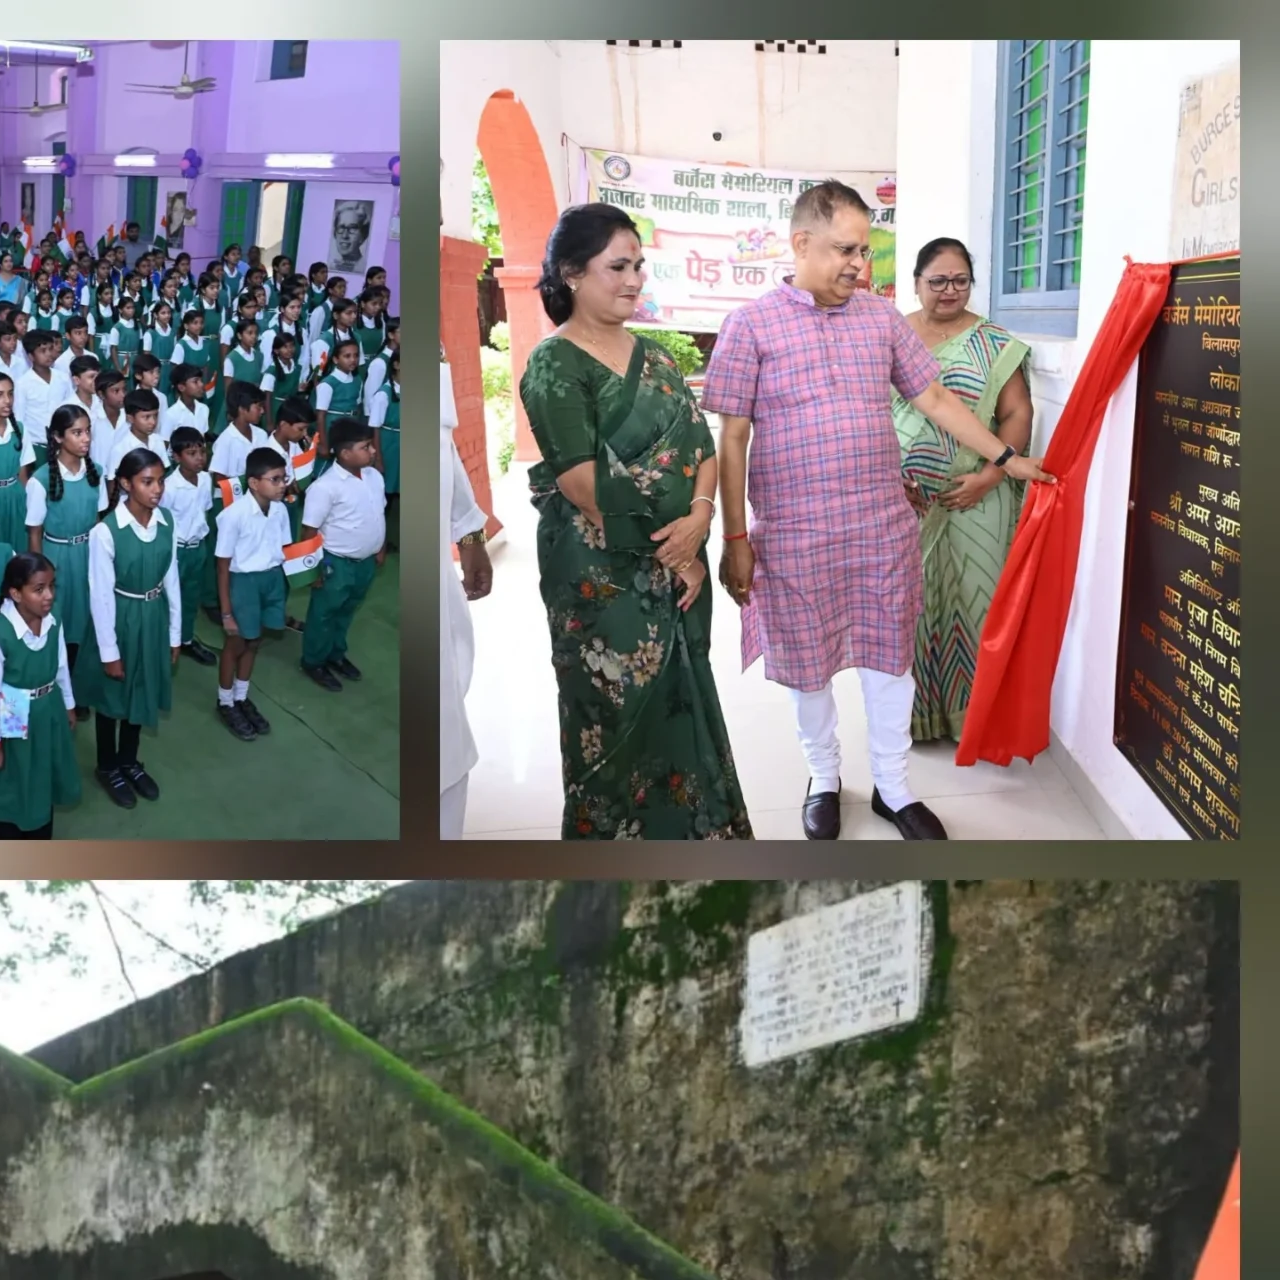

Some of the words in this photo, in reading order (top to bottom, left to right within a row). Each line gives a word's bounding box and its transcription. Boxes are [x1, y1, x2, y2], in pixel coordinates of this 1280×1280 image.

[721, 171, 794, 195] मेमोरियल
[1191, 167, 1238, 208] GIRLS
[650, 191, 721, 216] माध्यमिक
[653, 262, 681, 282] एक
[686, 250, 724, 288] पेड़
[732, 265, 767, 286] एक
[1201, 400, 1232, 419] अग्रवाल
[1192, 421, 1203, 435] का
[1181, 441, 1201, 458] लागत
[1203, 444, 1221, 465] राशि
[1198, 484, 1219, 503] मुख्य
[1169, 491, 1182, 512] श्री
[1186, 501, 1211, 527] अमर
[1211, 560, 1224, 578] एवं
[1187, 600, 1209, 630] पूजा
[1186, 629, 1203, 652] नगर
[1205, 638, 1228, 668] निगम
[1189, 659, 1215, 694] महेश
[1193, 746, 1227, 792] मंगलवार
[1225, 752, 1239, 774] की
[1178, 758, 1203, 794] संगम
[1205, 785, 1240, 833] शुक्ला
[1179, 784, 1191, 805] एवं
[1192, 799, 1217, 834] समस्त
